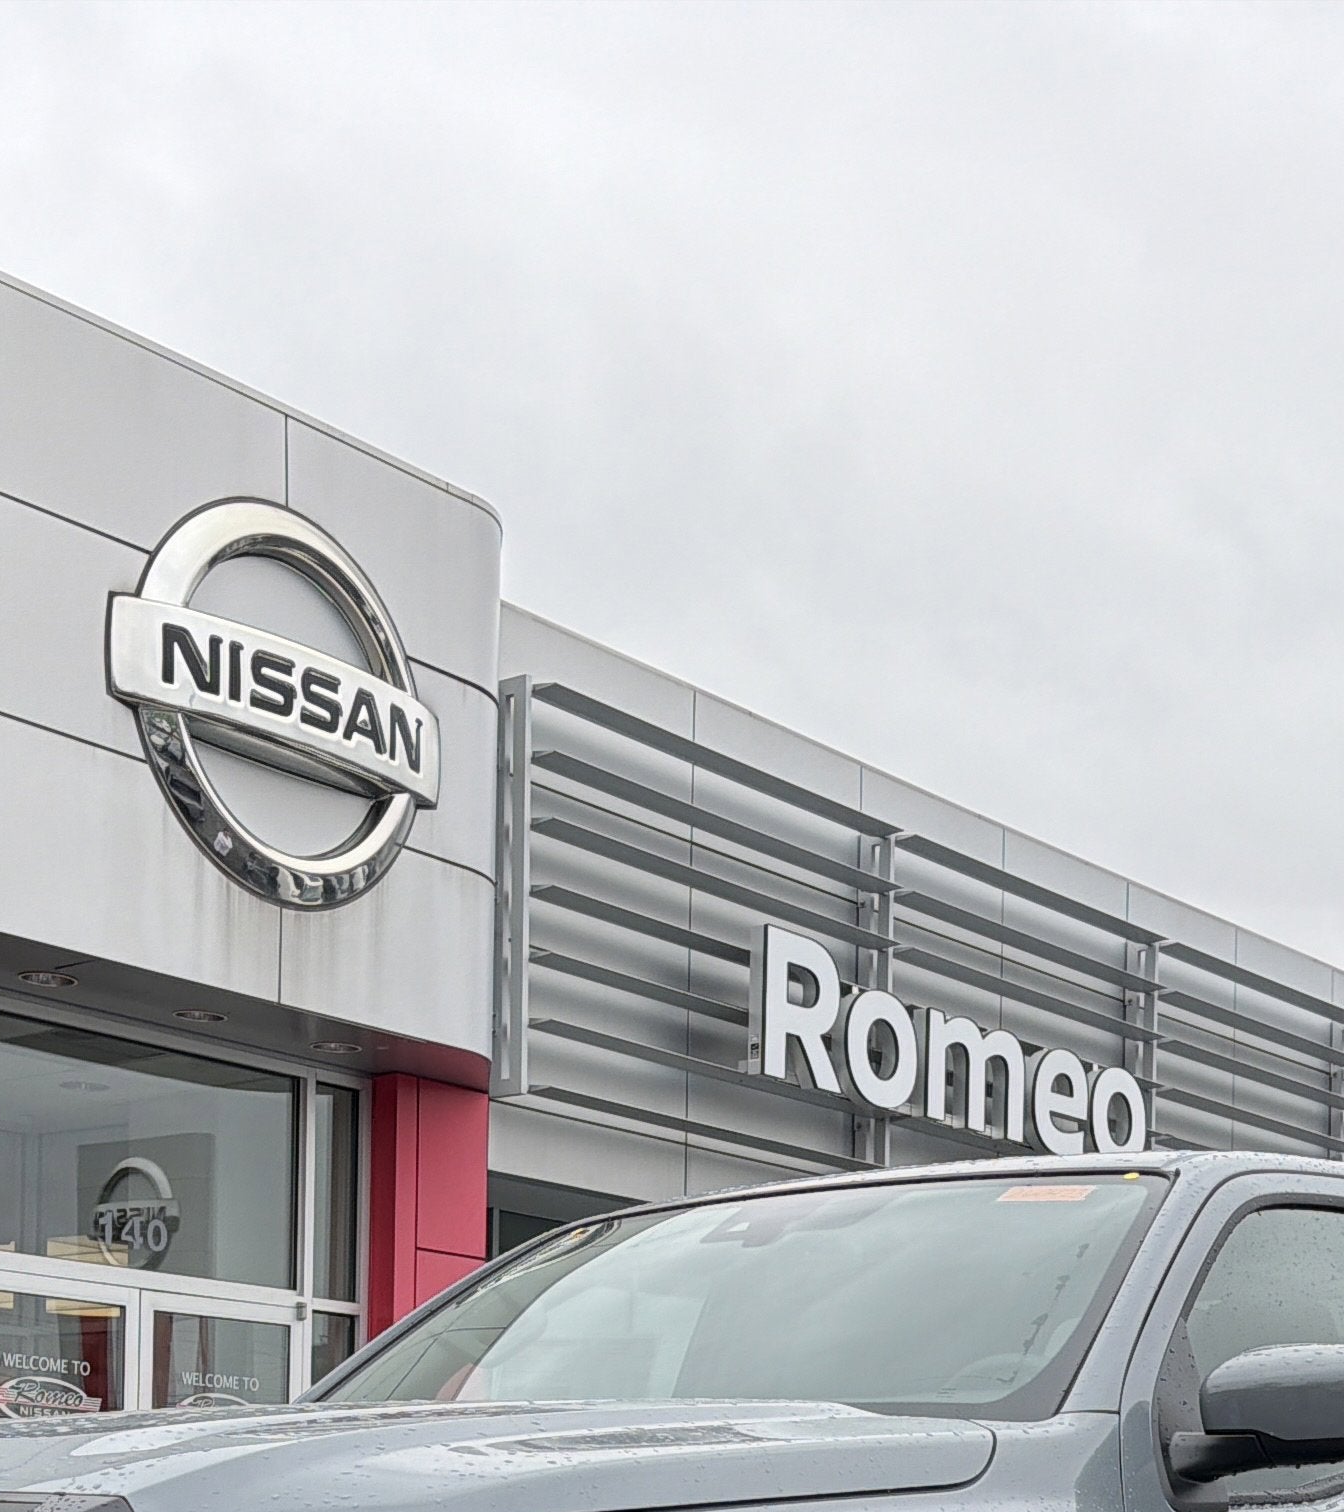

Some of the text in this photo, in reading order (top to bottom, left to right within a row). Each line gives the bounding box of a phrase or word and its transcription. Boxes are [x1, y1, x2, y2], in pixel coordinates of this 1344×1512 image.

[161, 622, 425, 774] NISSAN
[763, 923, 1147, 1155] Romeo
[98, 1210, 168, 1252] 140
[3, 1352, 91, 1377] WELCOME TO
[181, 1371, 260, 1392] WELCOME TO
[12, 1378, 84, 1408] Romeo
